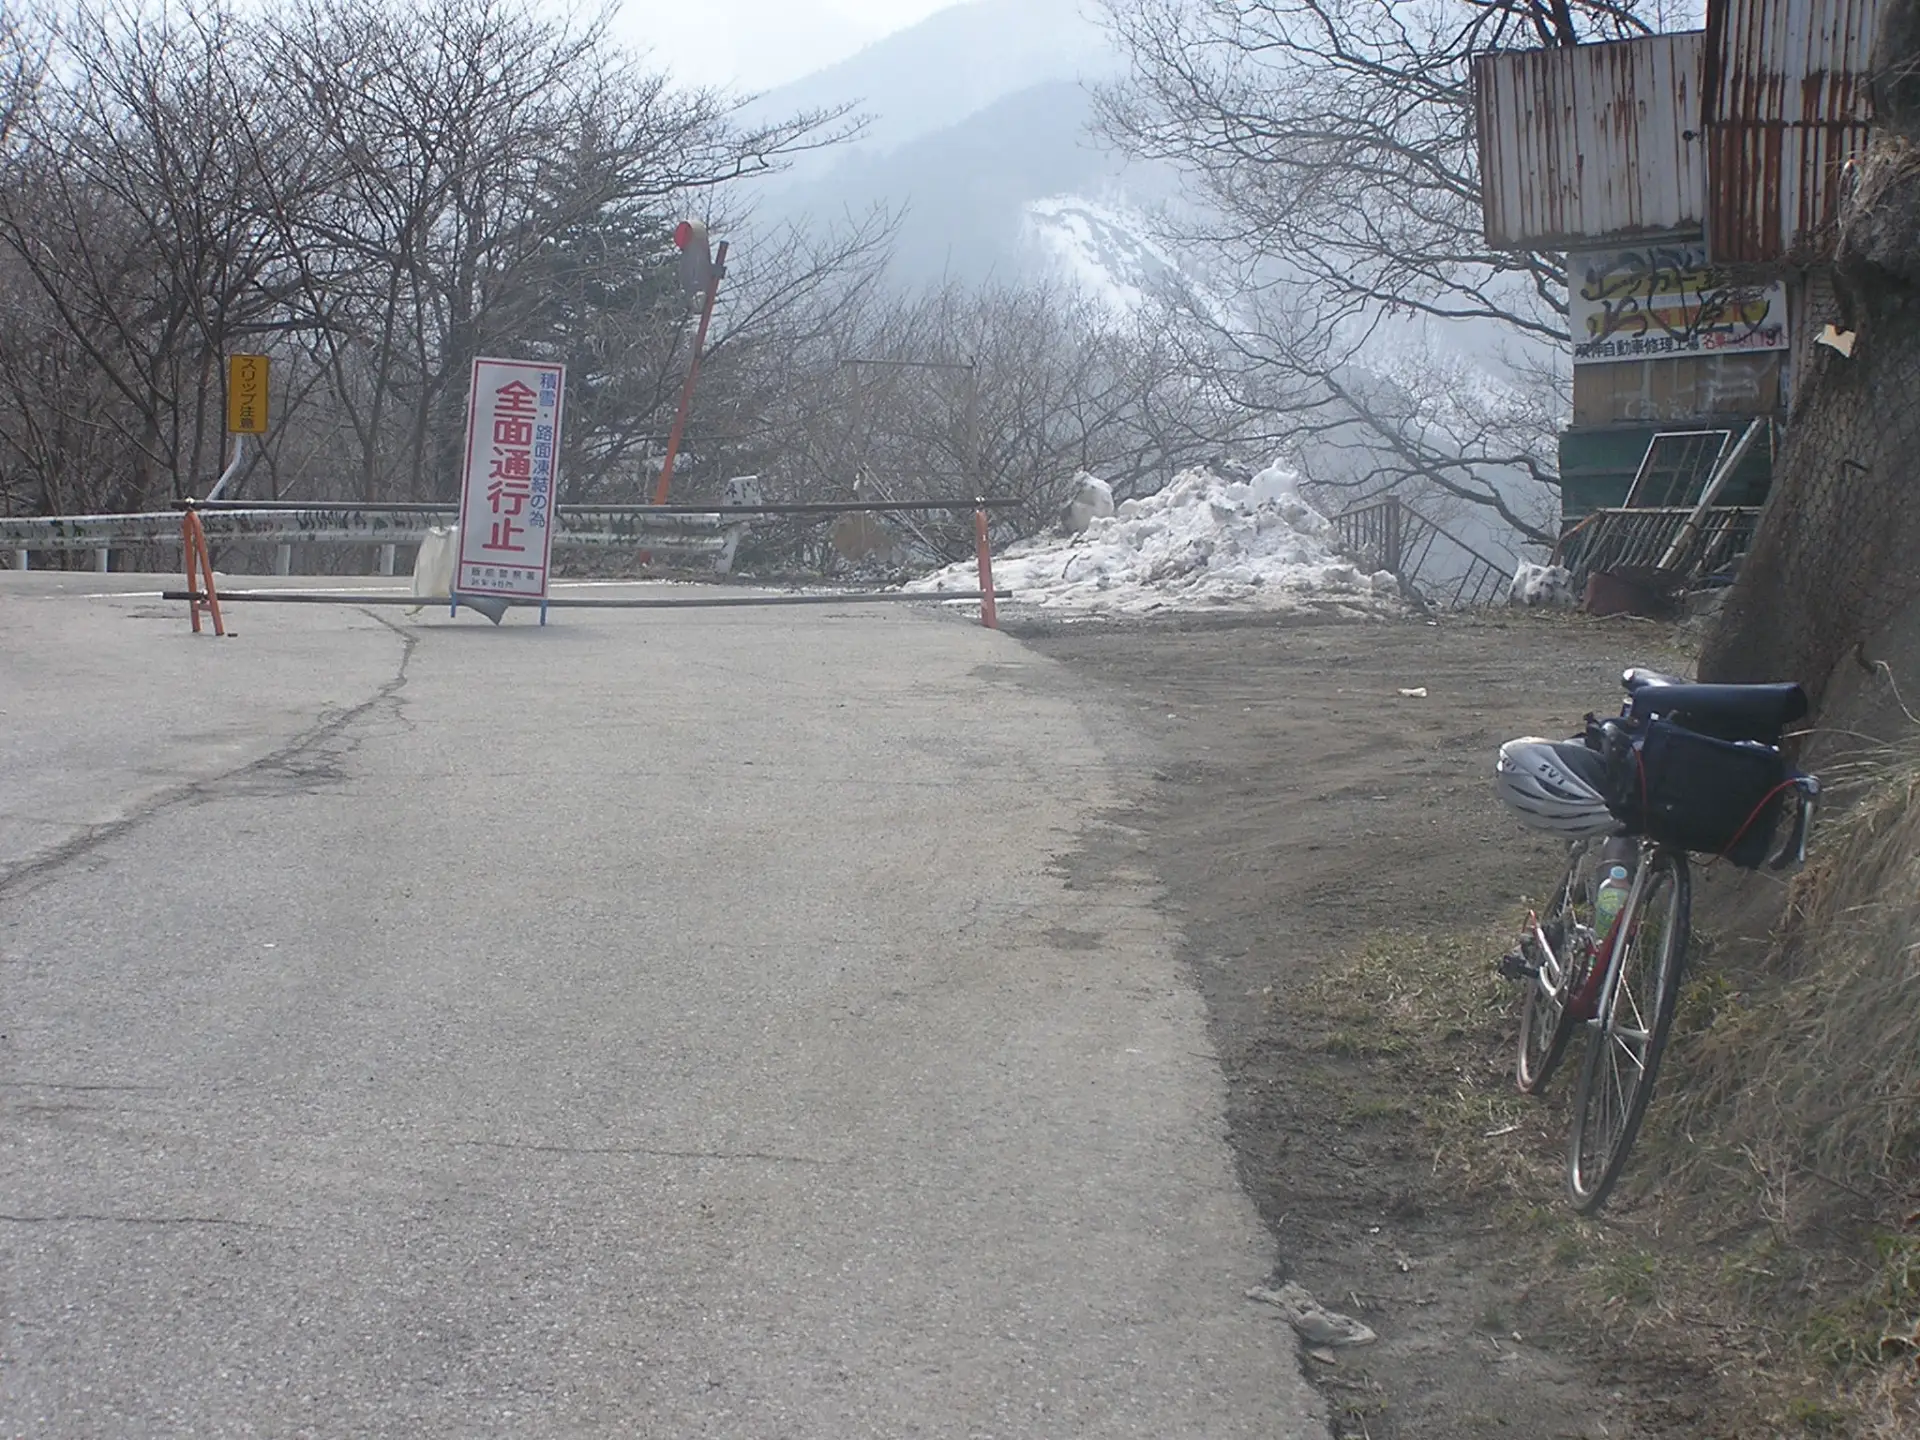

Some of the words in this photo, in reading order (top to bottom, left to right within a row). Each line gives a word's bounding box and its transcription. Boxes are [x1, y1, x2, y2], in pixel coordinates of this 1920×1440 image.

[482, 380, 537, 551] 全面通行止
[529, 372, 557, 528] 積雪・路面凍結の為
